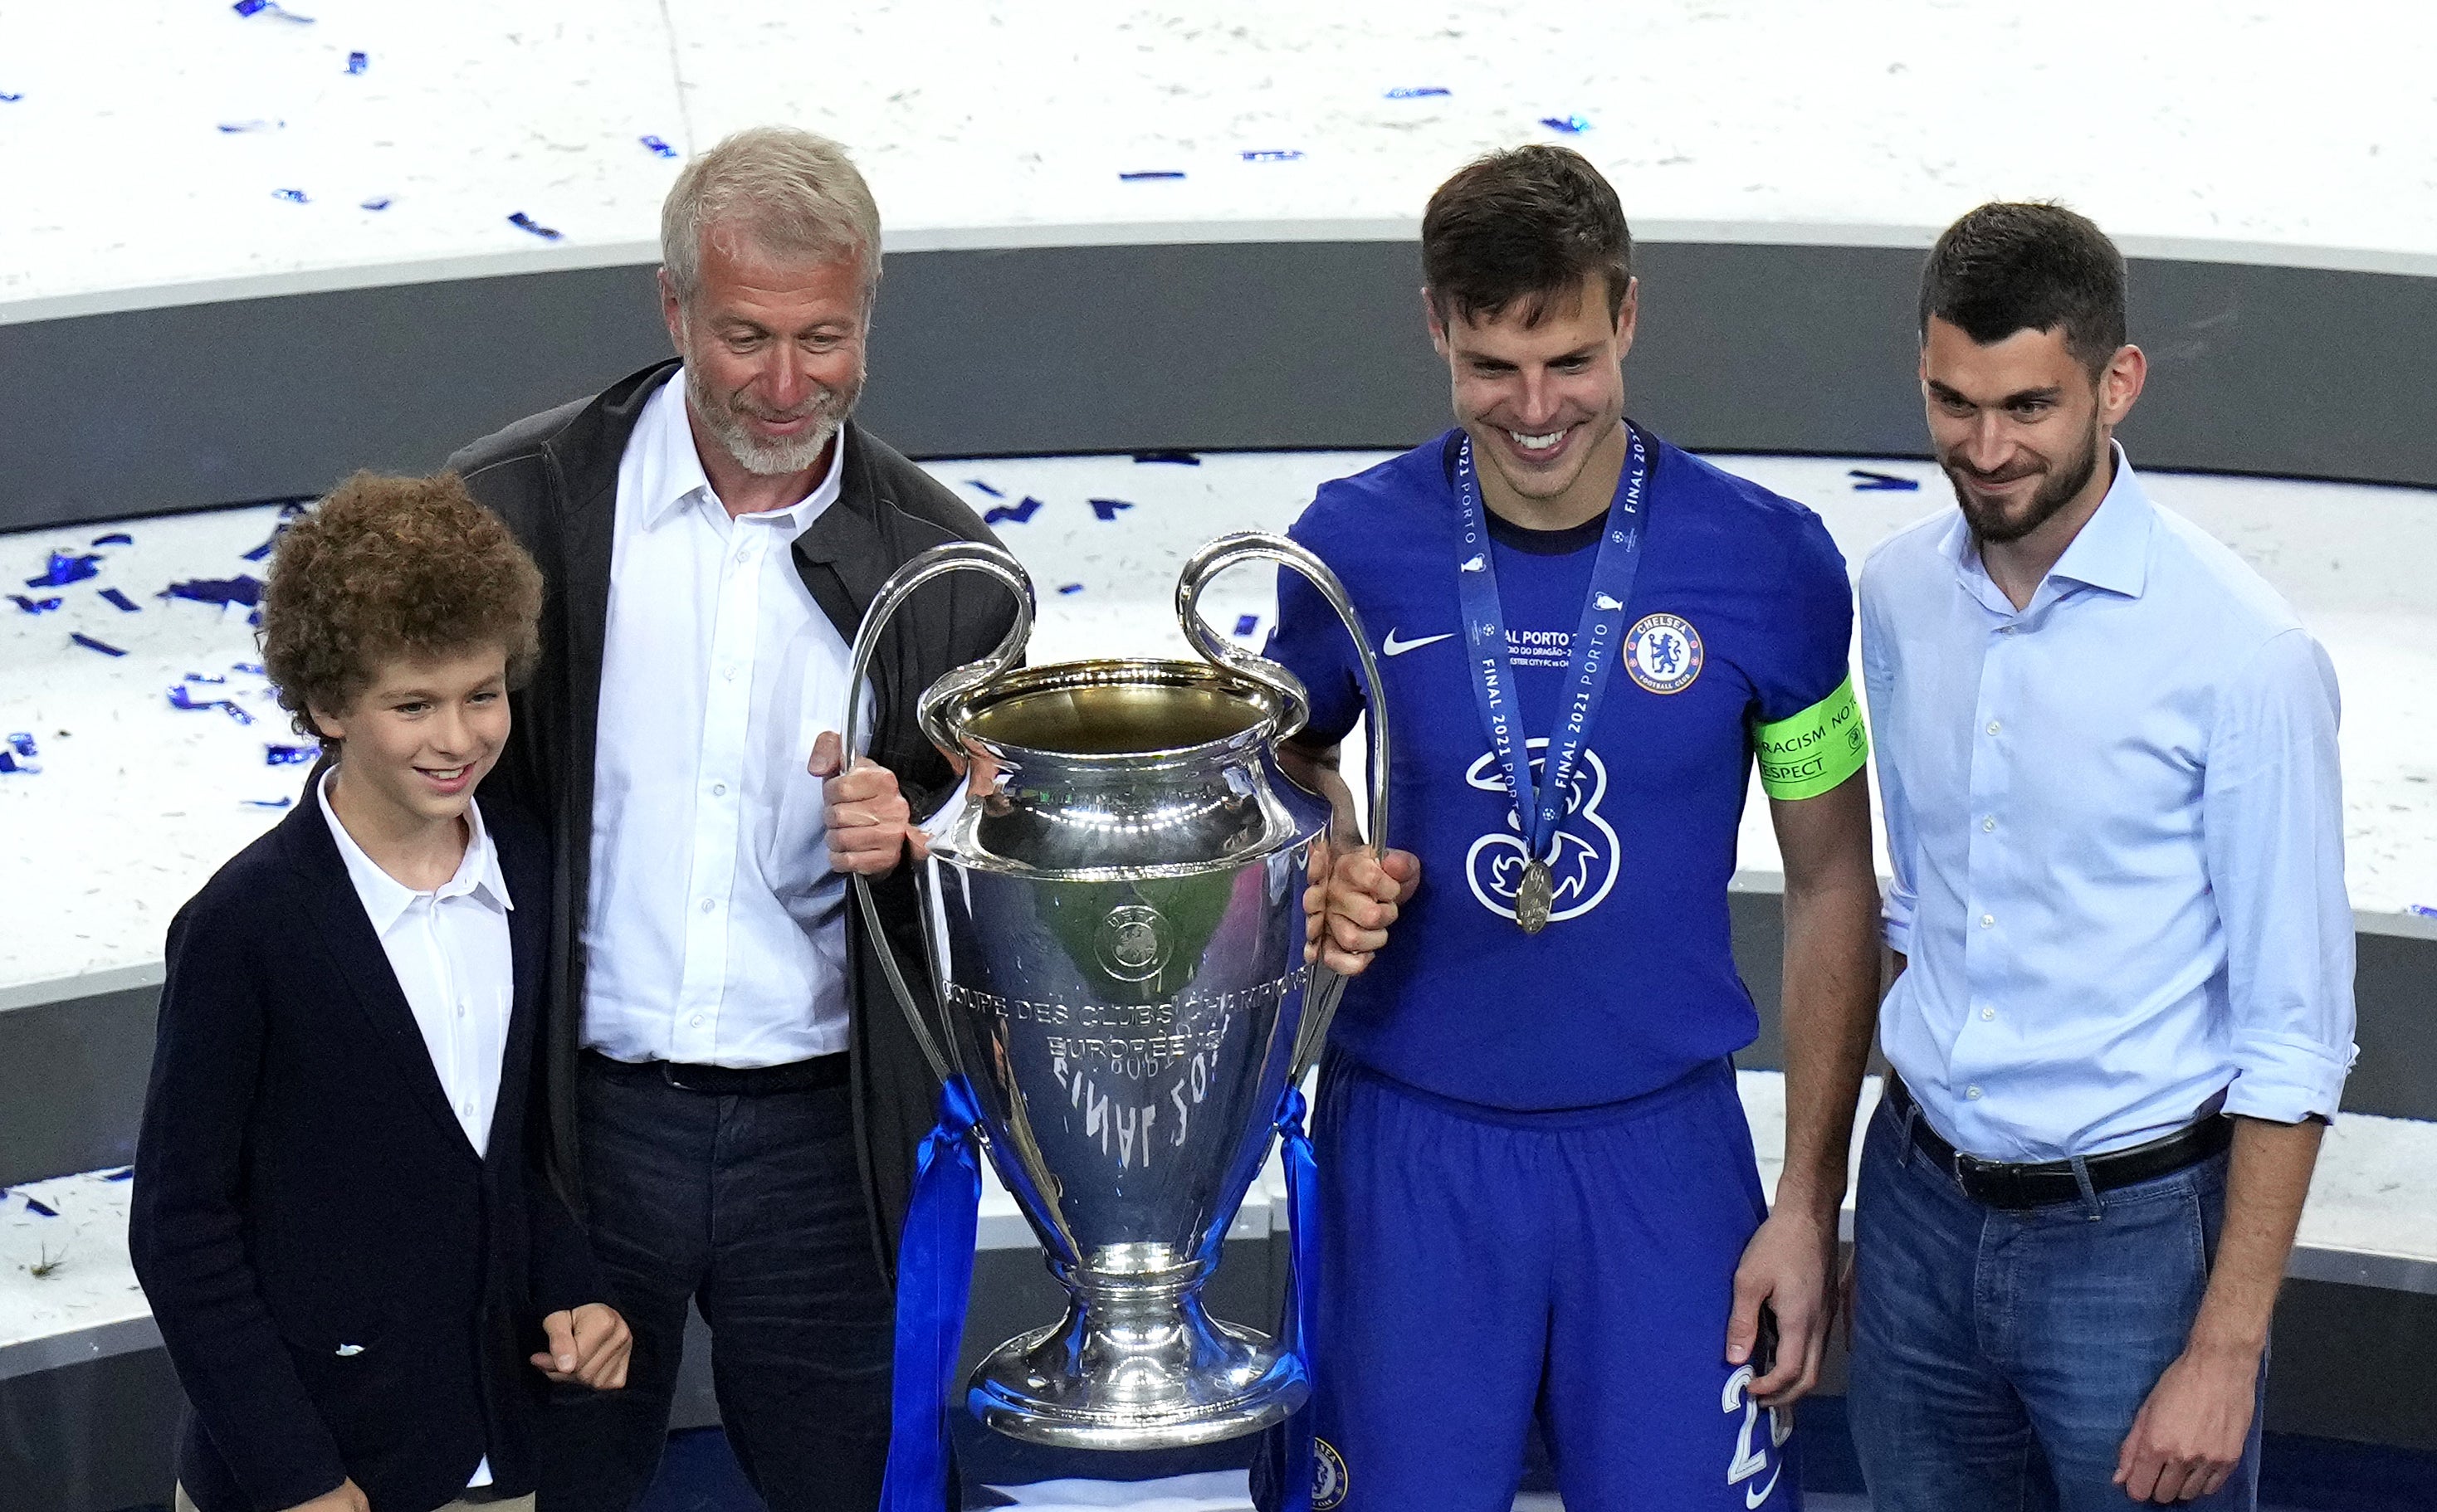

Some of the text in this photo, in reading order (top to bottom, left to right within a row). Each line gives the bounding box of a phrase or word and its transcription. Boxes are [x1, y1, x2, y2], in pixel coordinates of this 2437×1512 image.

[1629, 428, 1645, 462] 202
[1624, 469, 1643, 514] FINAL
[1461, 482, 1476, 544] PORTO
[1522, 631, 1569, 646] PORTO
[1637, 617, 1687, 634] CHELSEA
[1639, 673, 1691, 690] FOOTBALL CLUB
[1482, 658, 1502, 709] FINAL
[1492, 714, 1512, 757] 2021
[1555, 624, 1608, 788] FINAL 2021 PORTO
[1761, 725, 1826, 754] RACISM
[1831, 705, 1850, 729] NO
[1014, 999, 1069, 1024] DES
[1078, 1003, 1174, 1028] CLUBS
